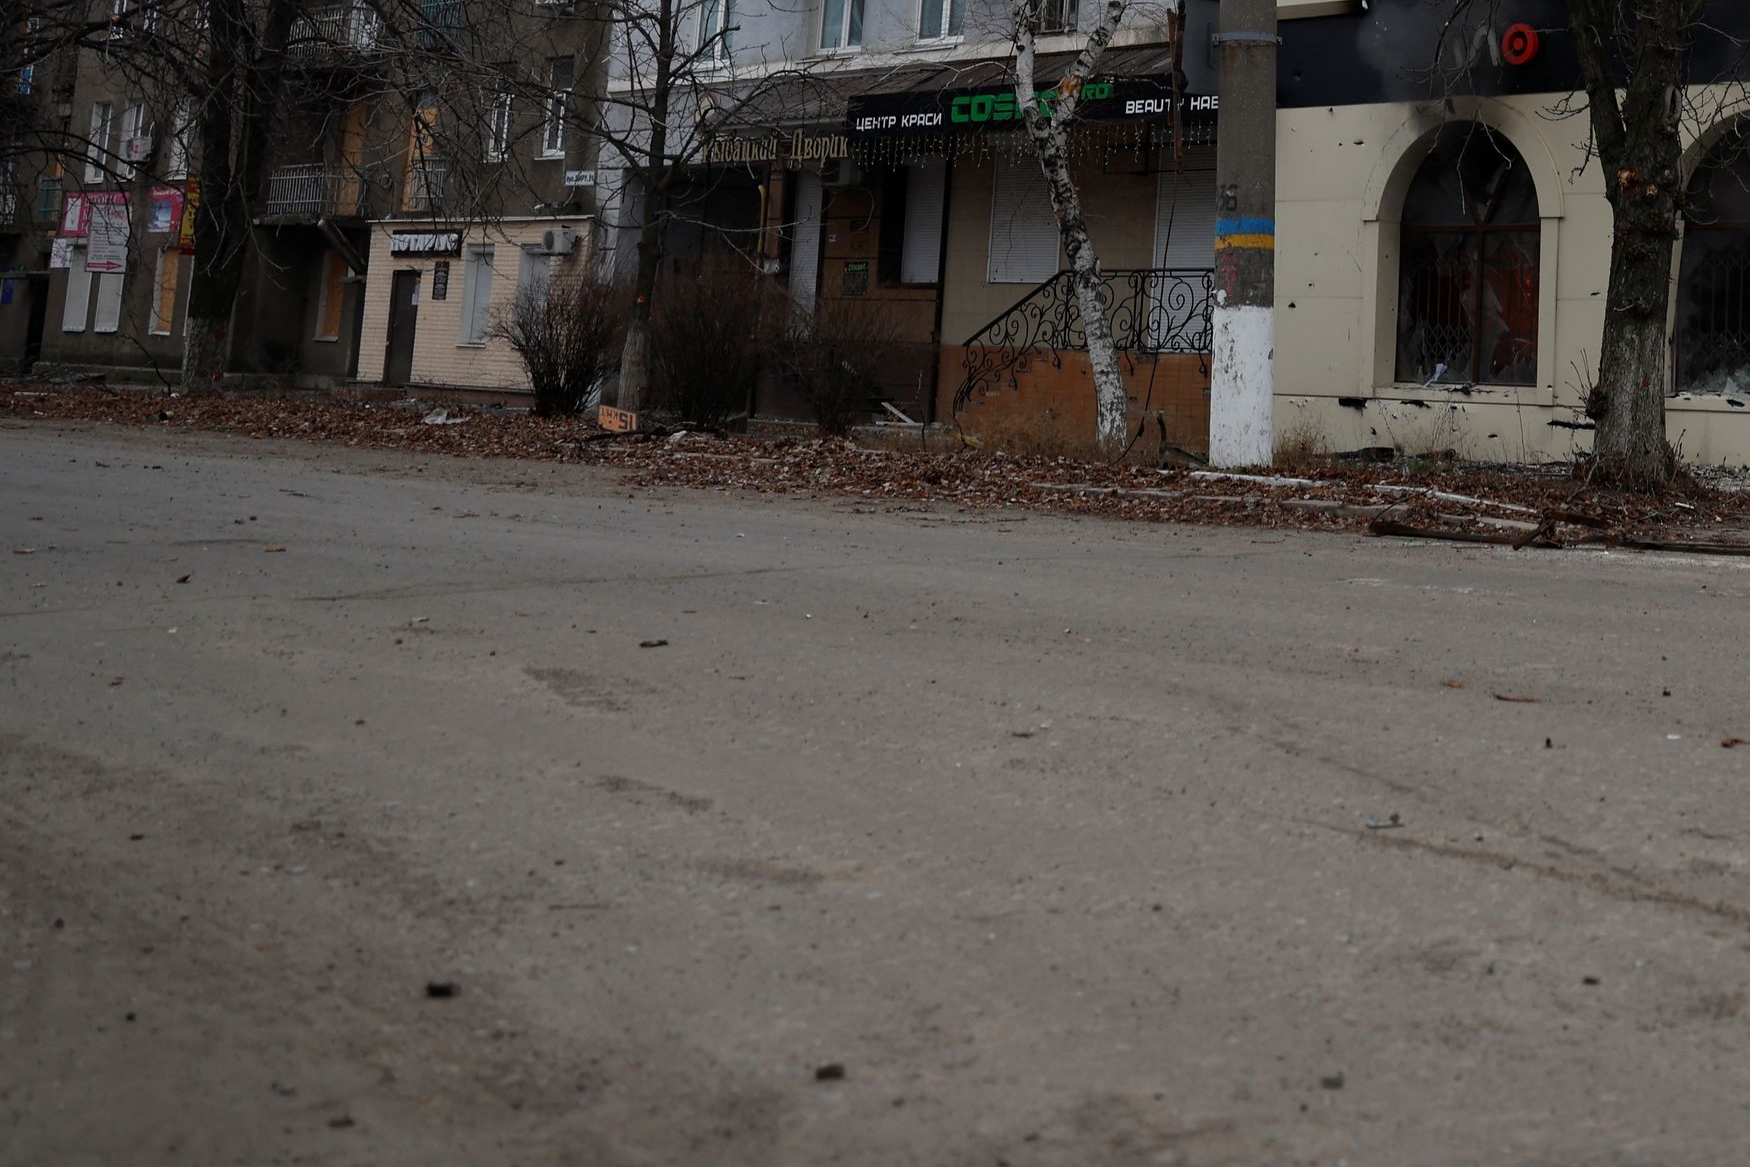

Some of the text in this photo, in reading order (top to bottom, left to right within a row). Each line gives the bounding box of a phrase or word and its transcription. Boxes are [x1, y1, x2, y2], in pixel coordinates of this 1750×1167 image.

[856, 112, 942, 132] ЦЕНТР КРАСИ
[790, 127, 848, 168] Дворик
